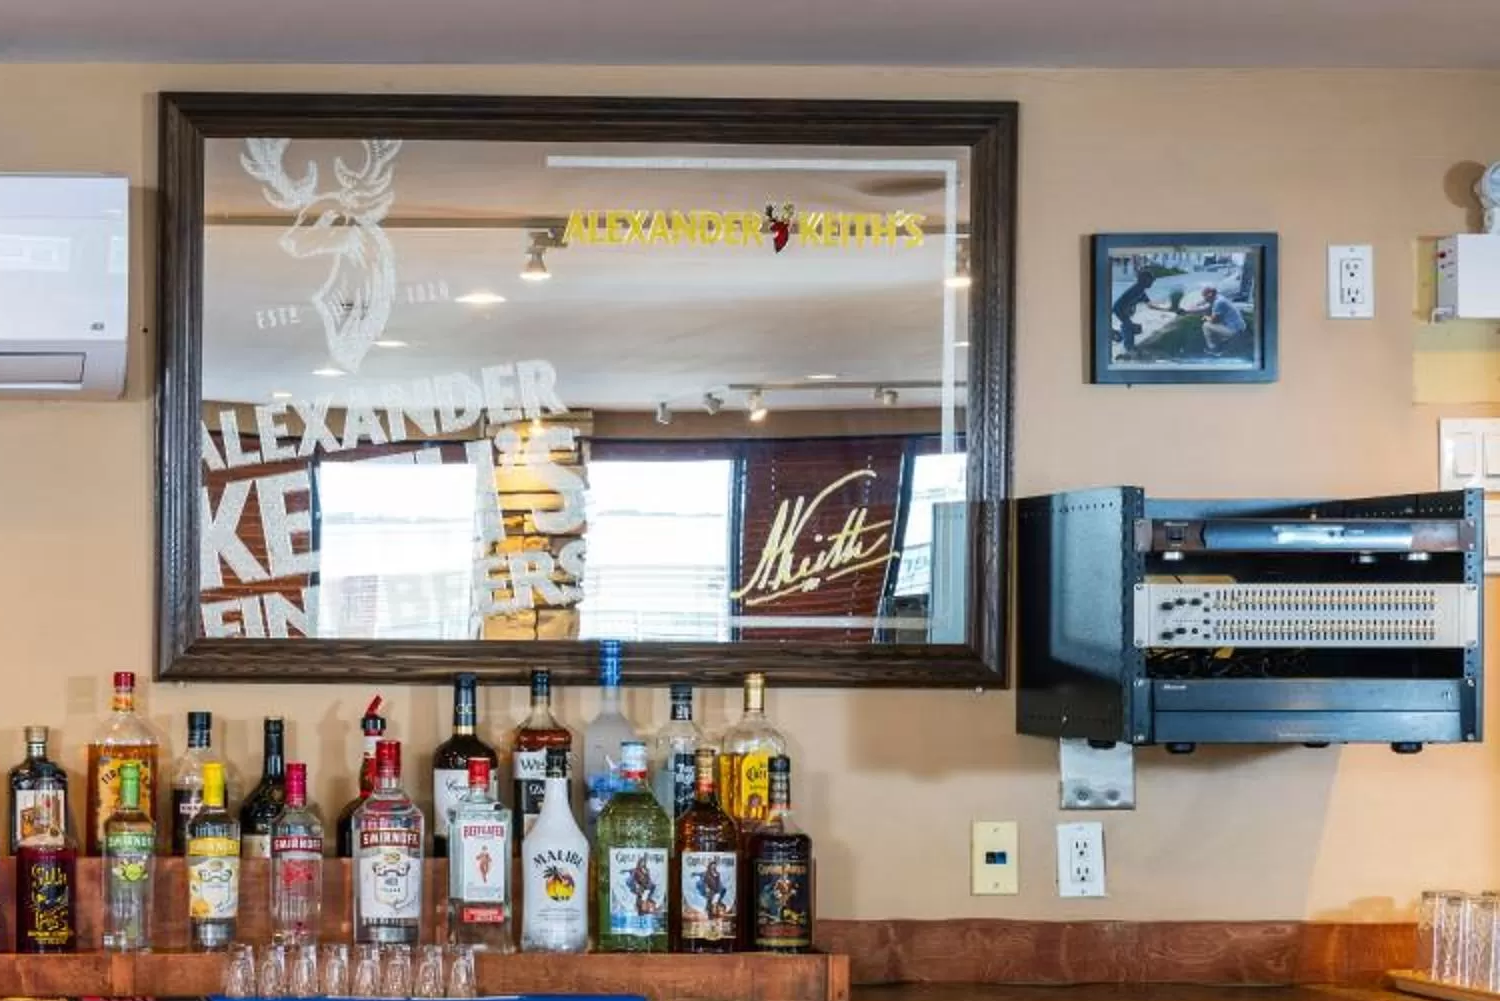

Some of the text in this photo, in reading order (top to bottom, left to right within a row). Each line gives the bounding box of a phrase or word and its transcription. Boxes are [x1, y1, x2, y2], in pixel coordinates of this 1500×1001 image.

[564, 208, 926, 248] ALEXANDER KEITH'S
[201, 359, 568, 475] ALEXANDER
[201, 425, 590, 593] KE'S
[363, 831, 420, 846] SMIRNOFF
[463, 825, 505, 838] BEEFEATER
[533, 849, 583, 868] MALIBU
